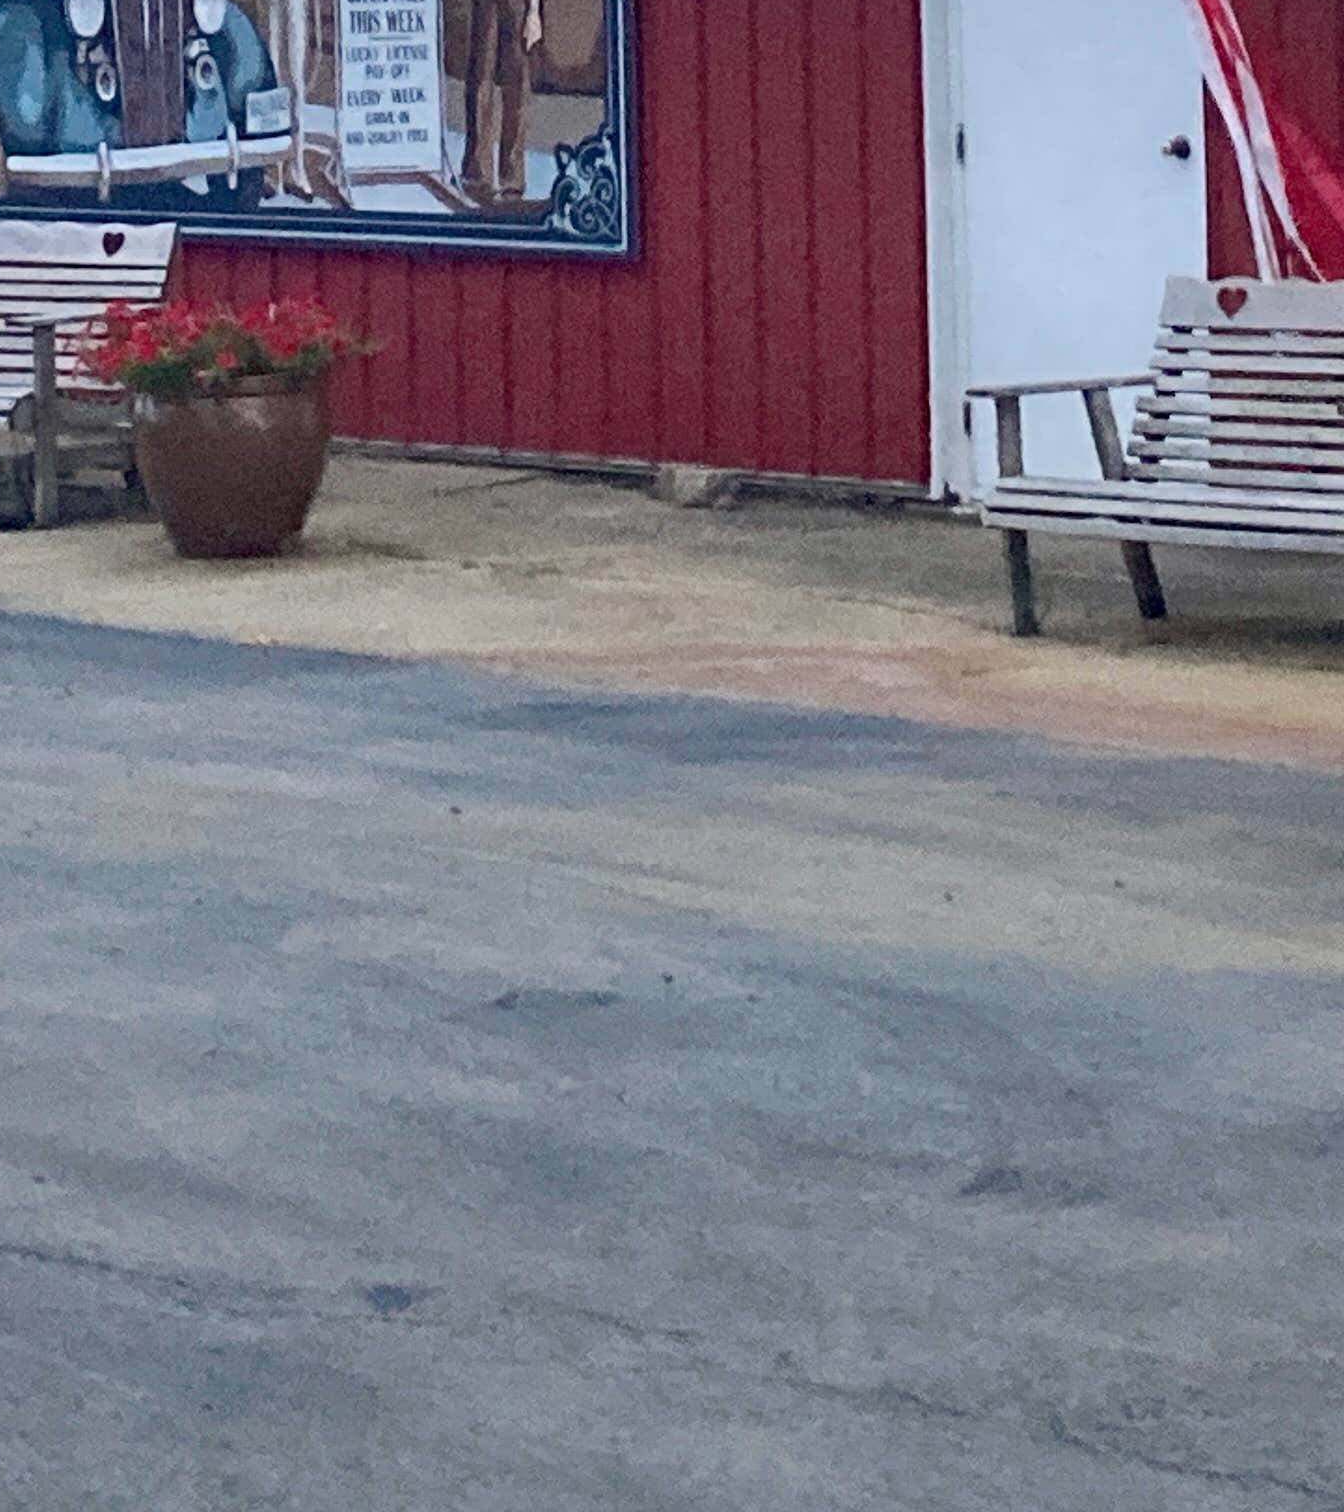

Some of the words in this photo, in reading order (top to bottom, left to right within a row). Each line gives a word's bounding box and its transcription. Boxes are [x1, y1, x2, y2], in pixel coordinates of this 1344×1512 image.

[350, 9, 381, 34] THIS
[385, 9, 425, 33] WEEK
[346, 47, 379, 62] LUCKY
[386, 44, 428, 61] LICENSE
[347, 89, 381, 106] EVERY
[391, 87, 426, 104] WEEK
